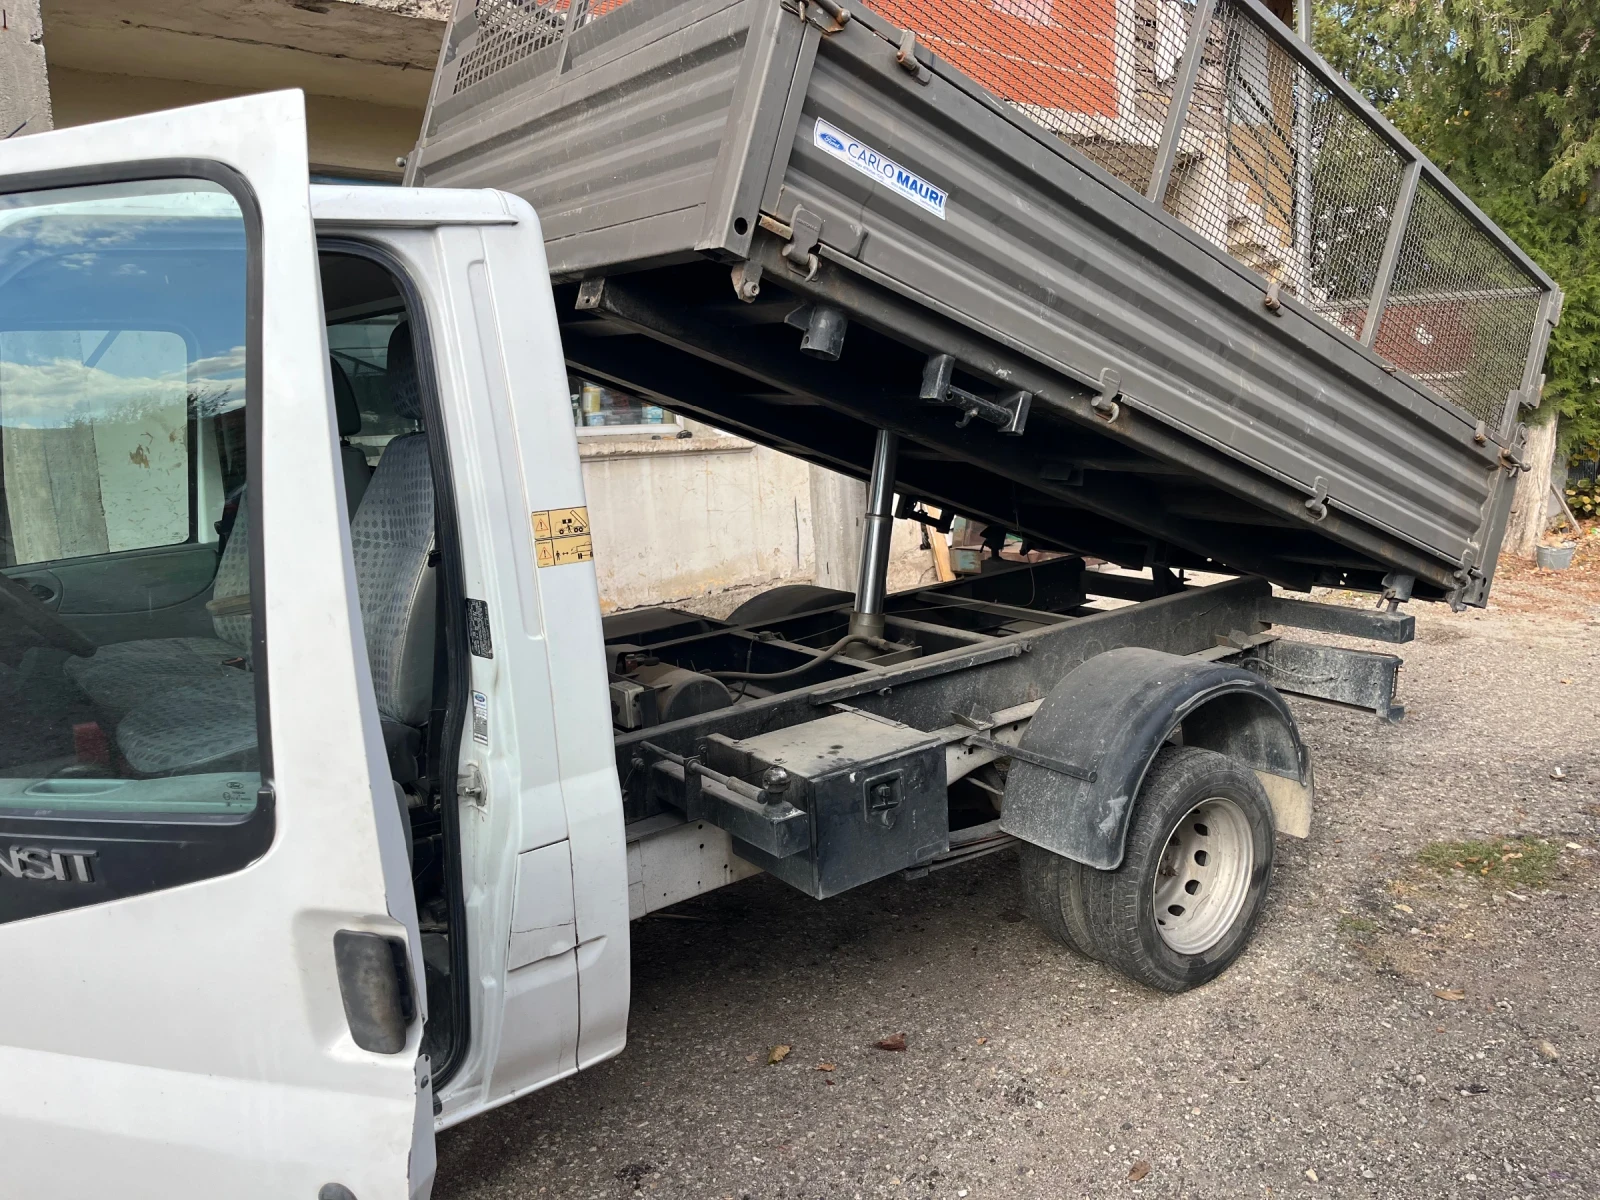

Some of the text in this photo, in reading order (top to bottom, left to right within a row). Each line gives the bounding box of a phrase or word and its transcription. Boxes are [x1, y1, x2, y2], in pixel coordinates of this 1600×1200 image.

[823, 135, 842, 149] Ford
[847, 143, 895, 178] CARLO
[897, 170, 944, 208] MAURI
